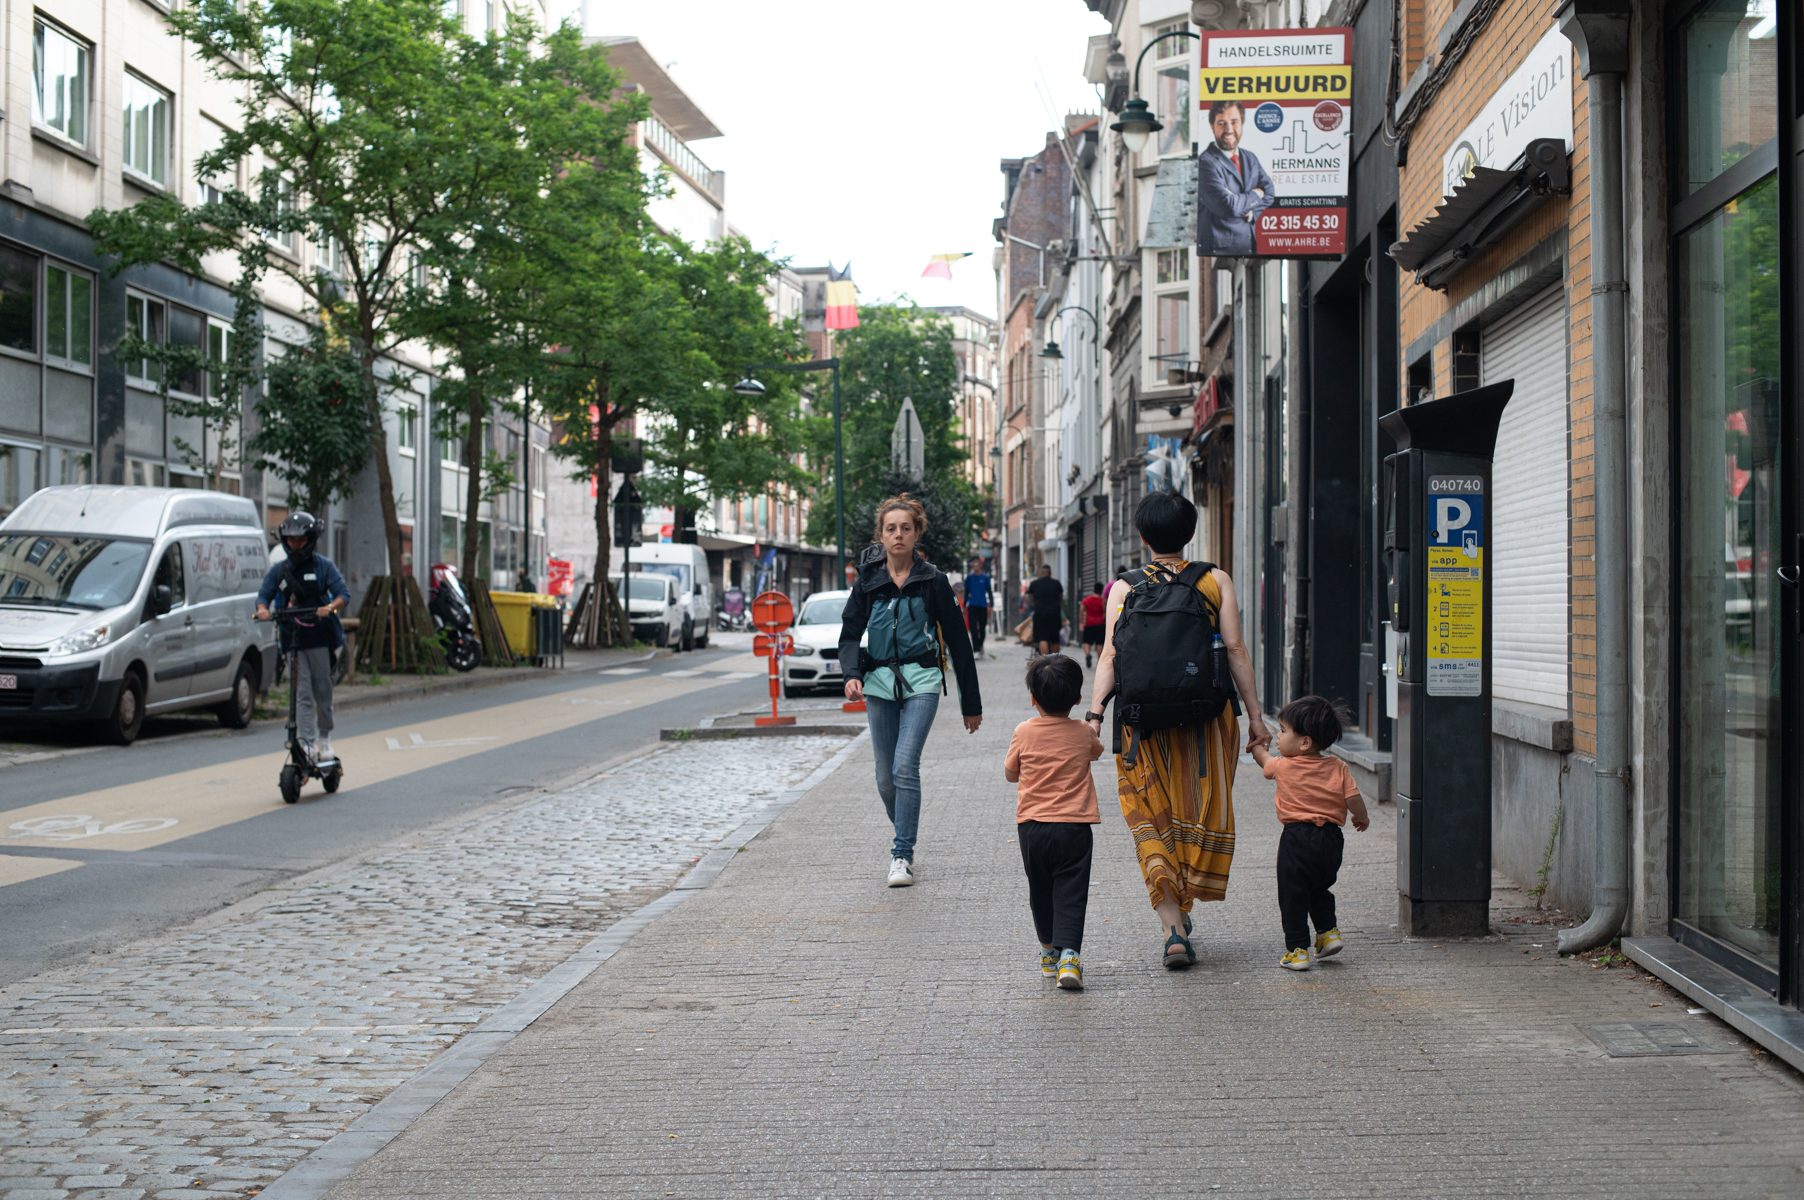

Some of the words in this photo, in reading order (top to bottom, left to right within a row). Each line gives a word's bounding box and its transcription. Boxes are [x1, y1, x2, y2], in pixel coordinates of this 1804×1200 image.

[1219, 43, 1333, 58] HANDELSRUIMTE
[1204, 74, 1347, 94] VERHUURD
[1500, 53, 1566, 138] Vision
[1272, 157, 1340, 169] HERMANNS
[1272, 174, 1297, 184] REAL
[1302, 173, 1340, 184] ESTATE
[1280, 198, 1301, 206] GRATIS
[1262, 215, 1277, 230] 02
[1280, 215, 1300, 230] 315
[1303, 215, 1319, 229] 45
[1323, 215, 1338, 229] 30
[1269, 237, 1330, 247] WWW.AHRE.BE
[1431, 479, 1481, 491] 040740
[1436, 497, 1472, 544] P
[1439, 557, 1458, 566] app
